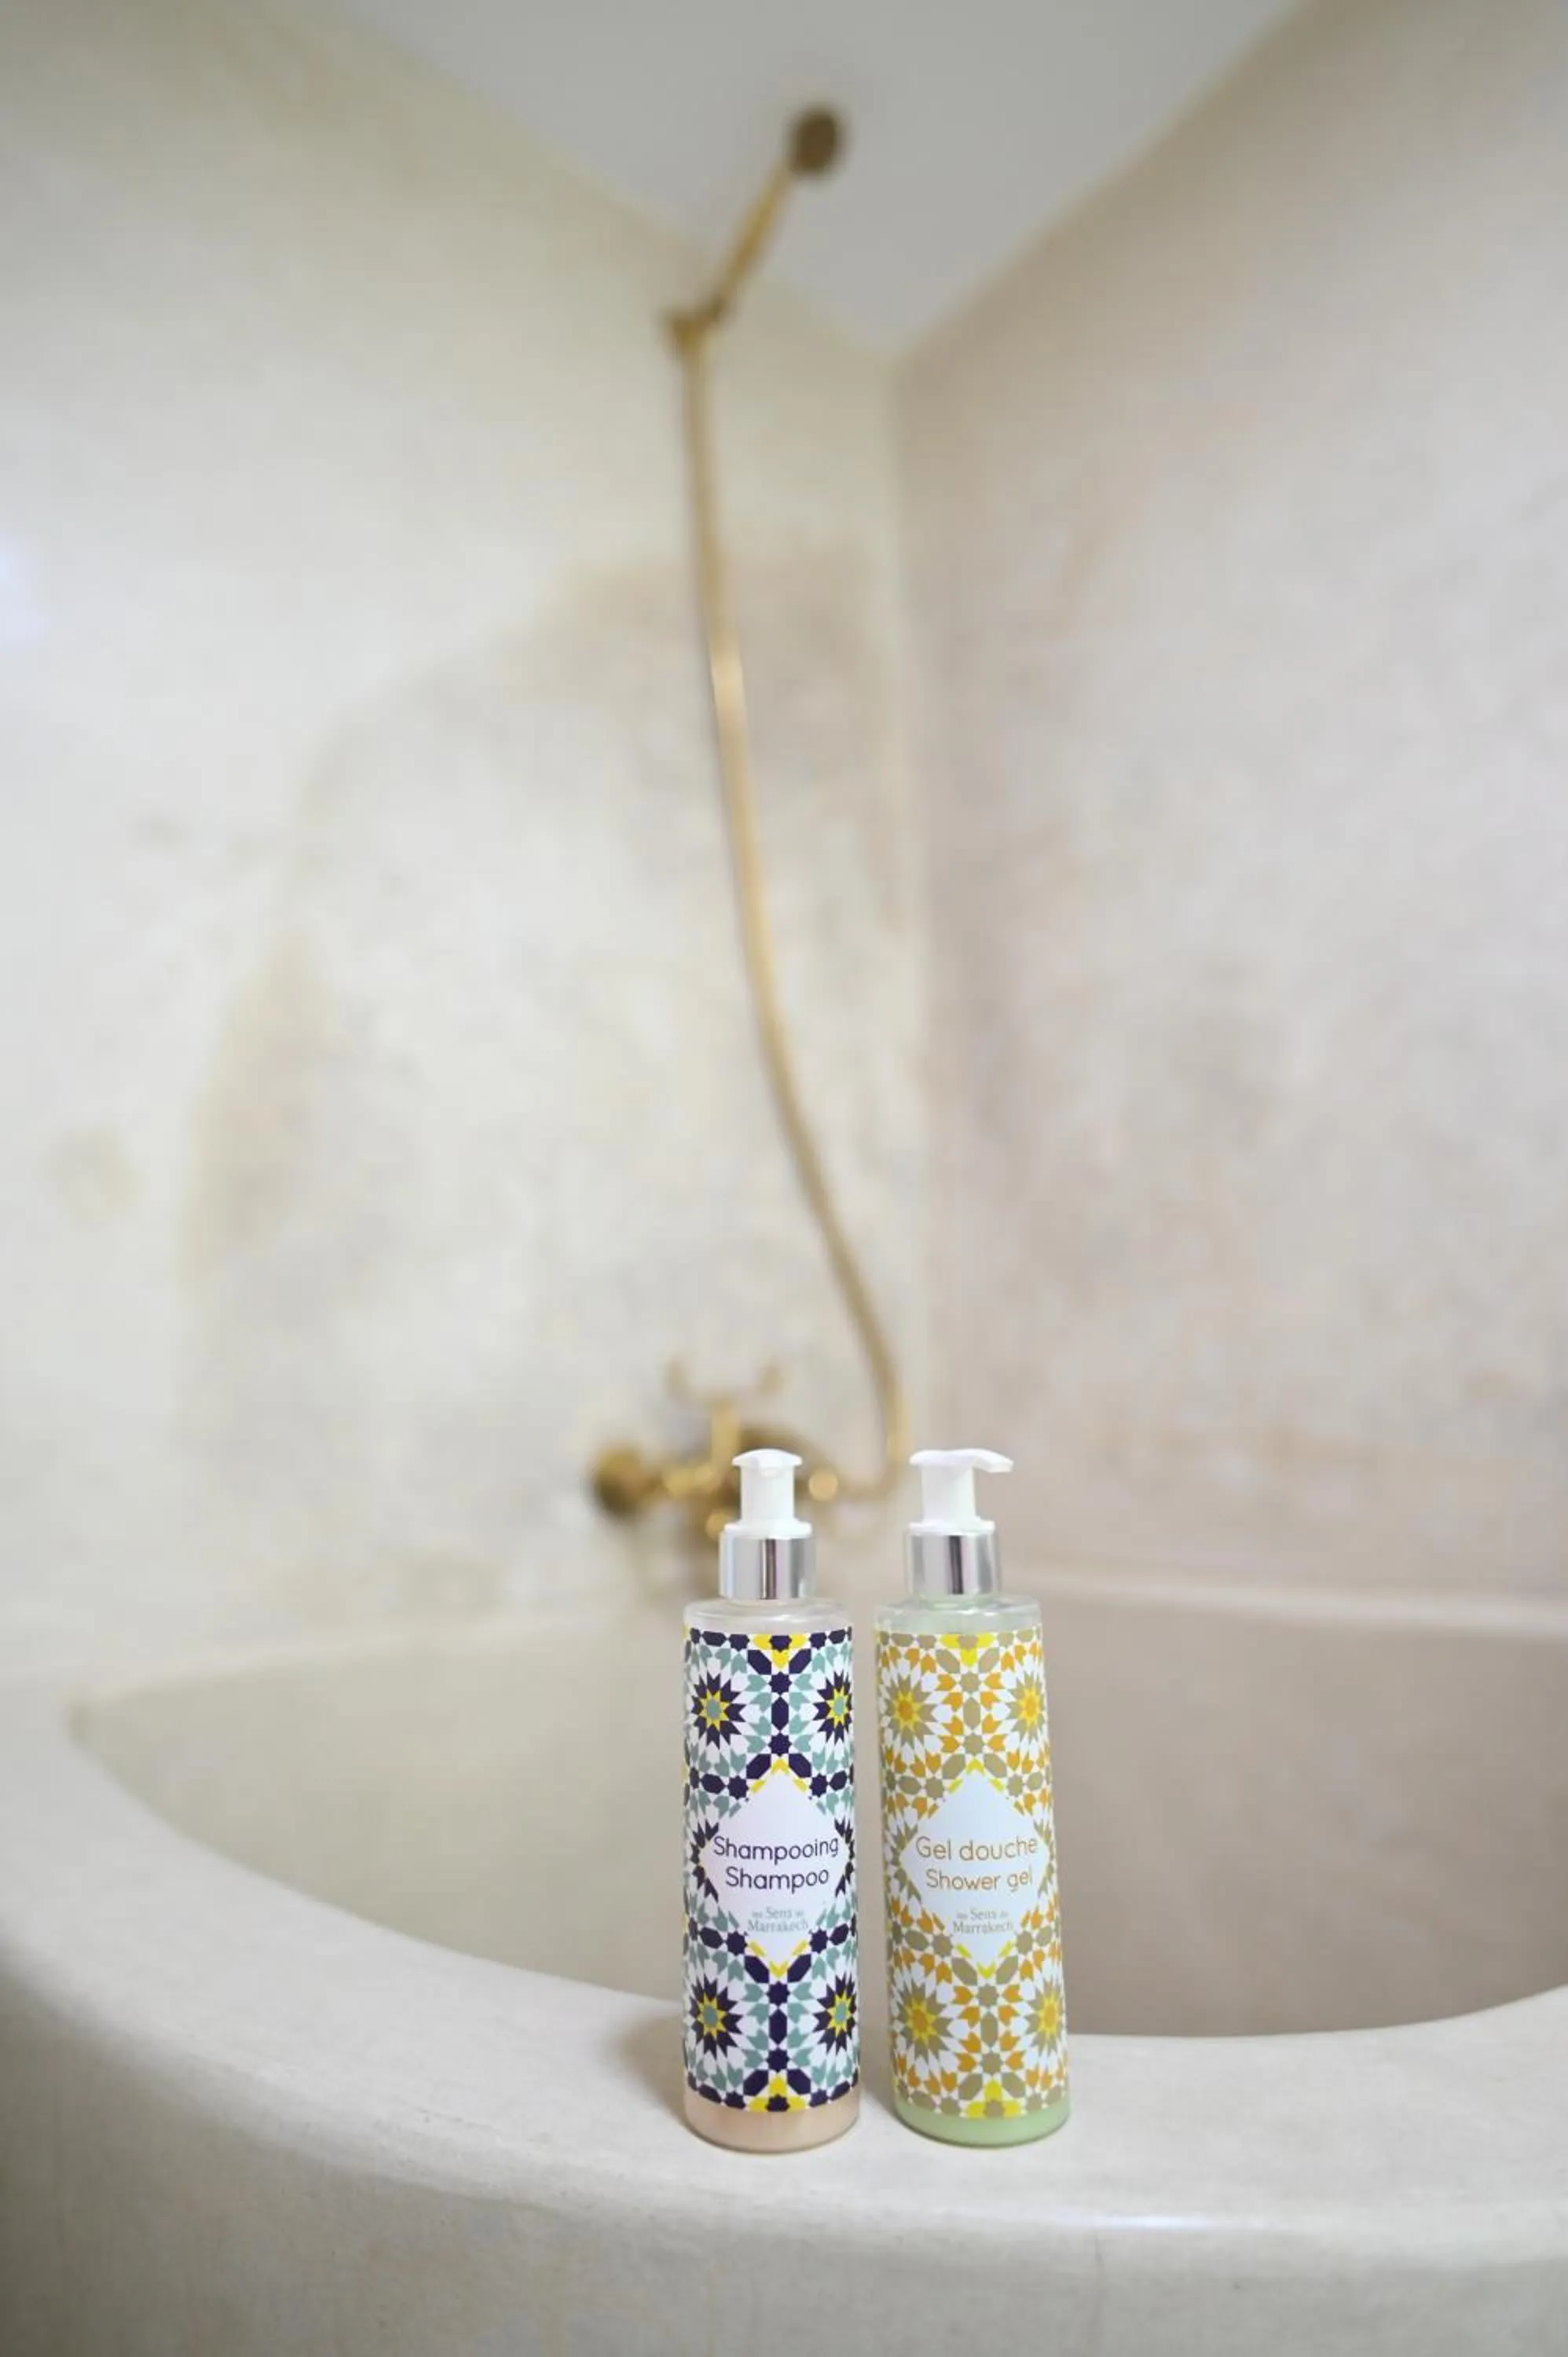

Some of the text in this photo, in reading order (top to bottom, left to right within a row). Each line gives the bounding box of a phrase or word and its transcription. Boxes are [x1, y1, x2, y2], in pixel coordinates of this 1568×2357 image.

[713, 1836, 838, 1865] Shampooing
[915, 1835, 1038, 1861] Gel douche
[725, 1866, 829, 1894] Shampoo
[926, 1866, 1033, 1892] Shower gel
